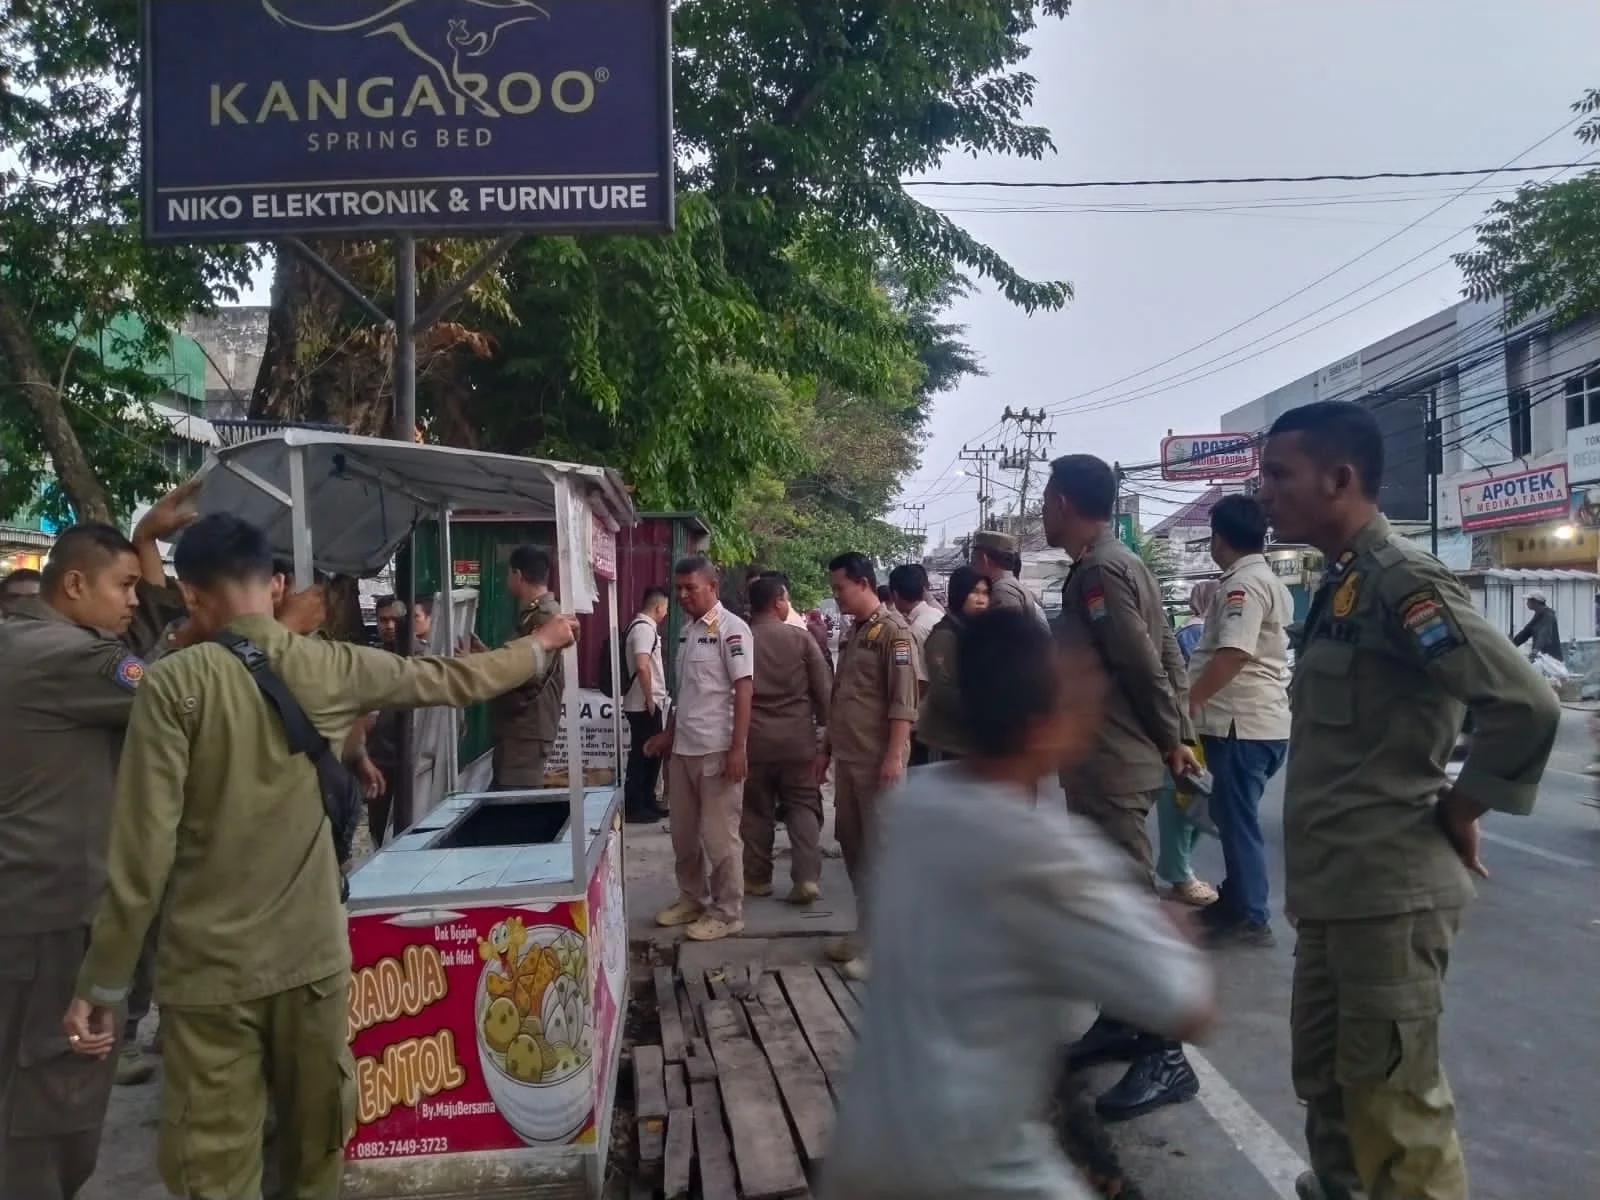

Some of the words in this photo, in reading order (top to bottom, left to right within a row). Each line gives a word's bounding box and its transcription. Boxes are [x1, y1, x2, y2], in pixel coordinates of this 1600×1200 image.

[210, 70, 595, 127] KANGAROO
[307, 131, 417, 152] SPRING
[436, 127, 493, 148] BED
[168, 195, 243, 222] NIKO
[252, 189, 440, 219] ELEKTRONIK
[448, 187, 470, 213] &
[479, 185, 647, 213] FURNITURE
[1476, 497, 1519, 513] MEDIKA
[1523, 489, 1564, 505] FARMA
[1482, 471, 1555, 502] APOTEK
[346, 944, 449, 1043] RADJA
[352, 1029, 466, 1125] ENTOL
[422, 1100, 497, 1121] By.MajuBersama
[357, 1136, 448, 1158] 0882-7449-3723
